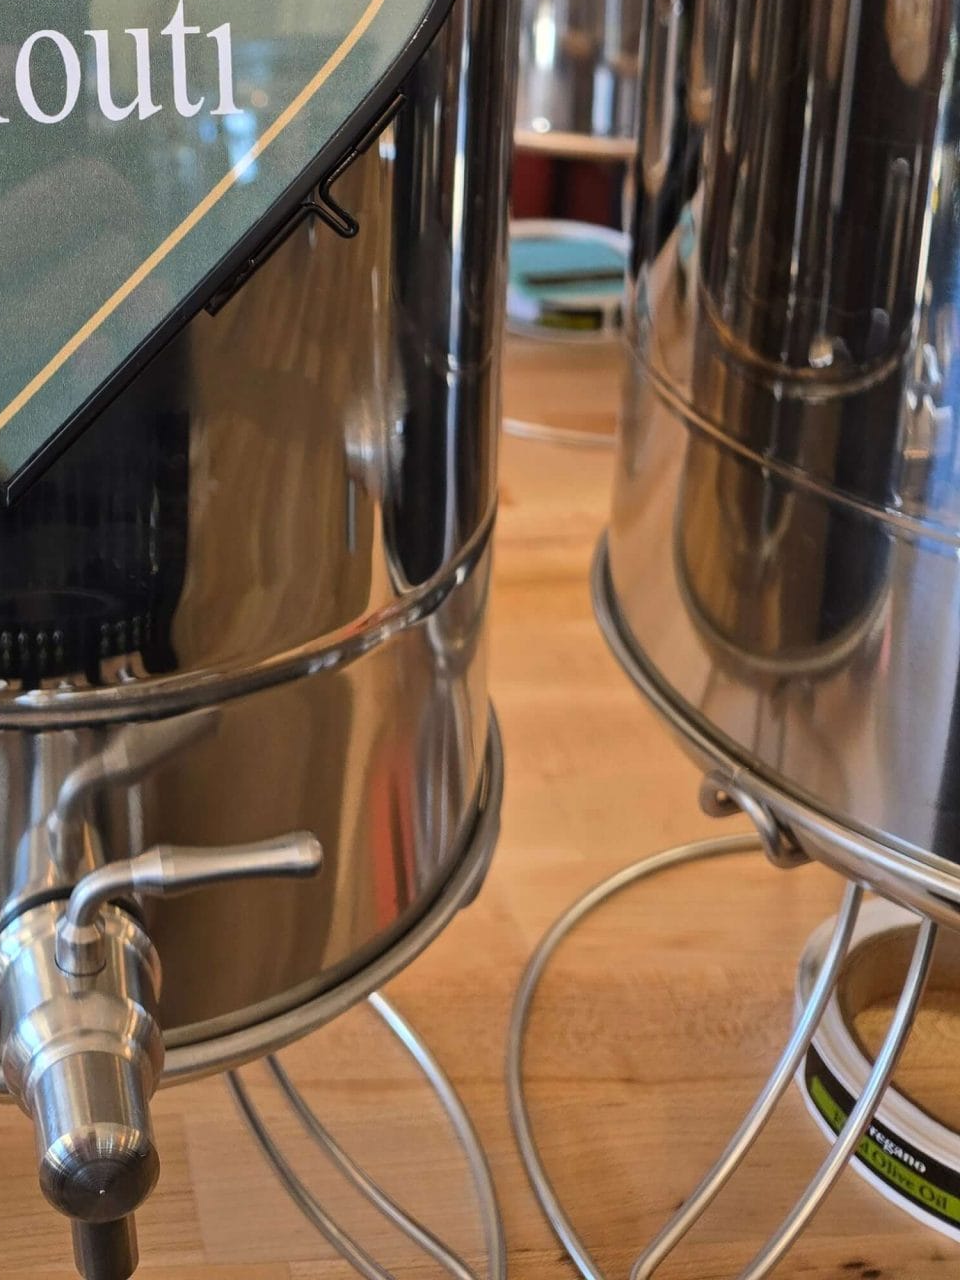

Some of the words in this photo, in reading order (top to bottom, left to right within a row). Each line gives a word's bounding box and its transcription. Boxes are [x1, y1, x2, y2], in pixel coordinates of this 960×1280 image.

[868, 1124, 927, 1173] regano
[871, 1150, 915, 1190] Olive
[918, 1185, 947, 1211] Oil
